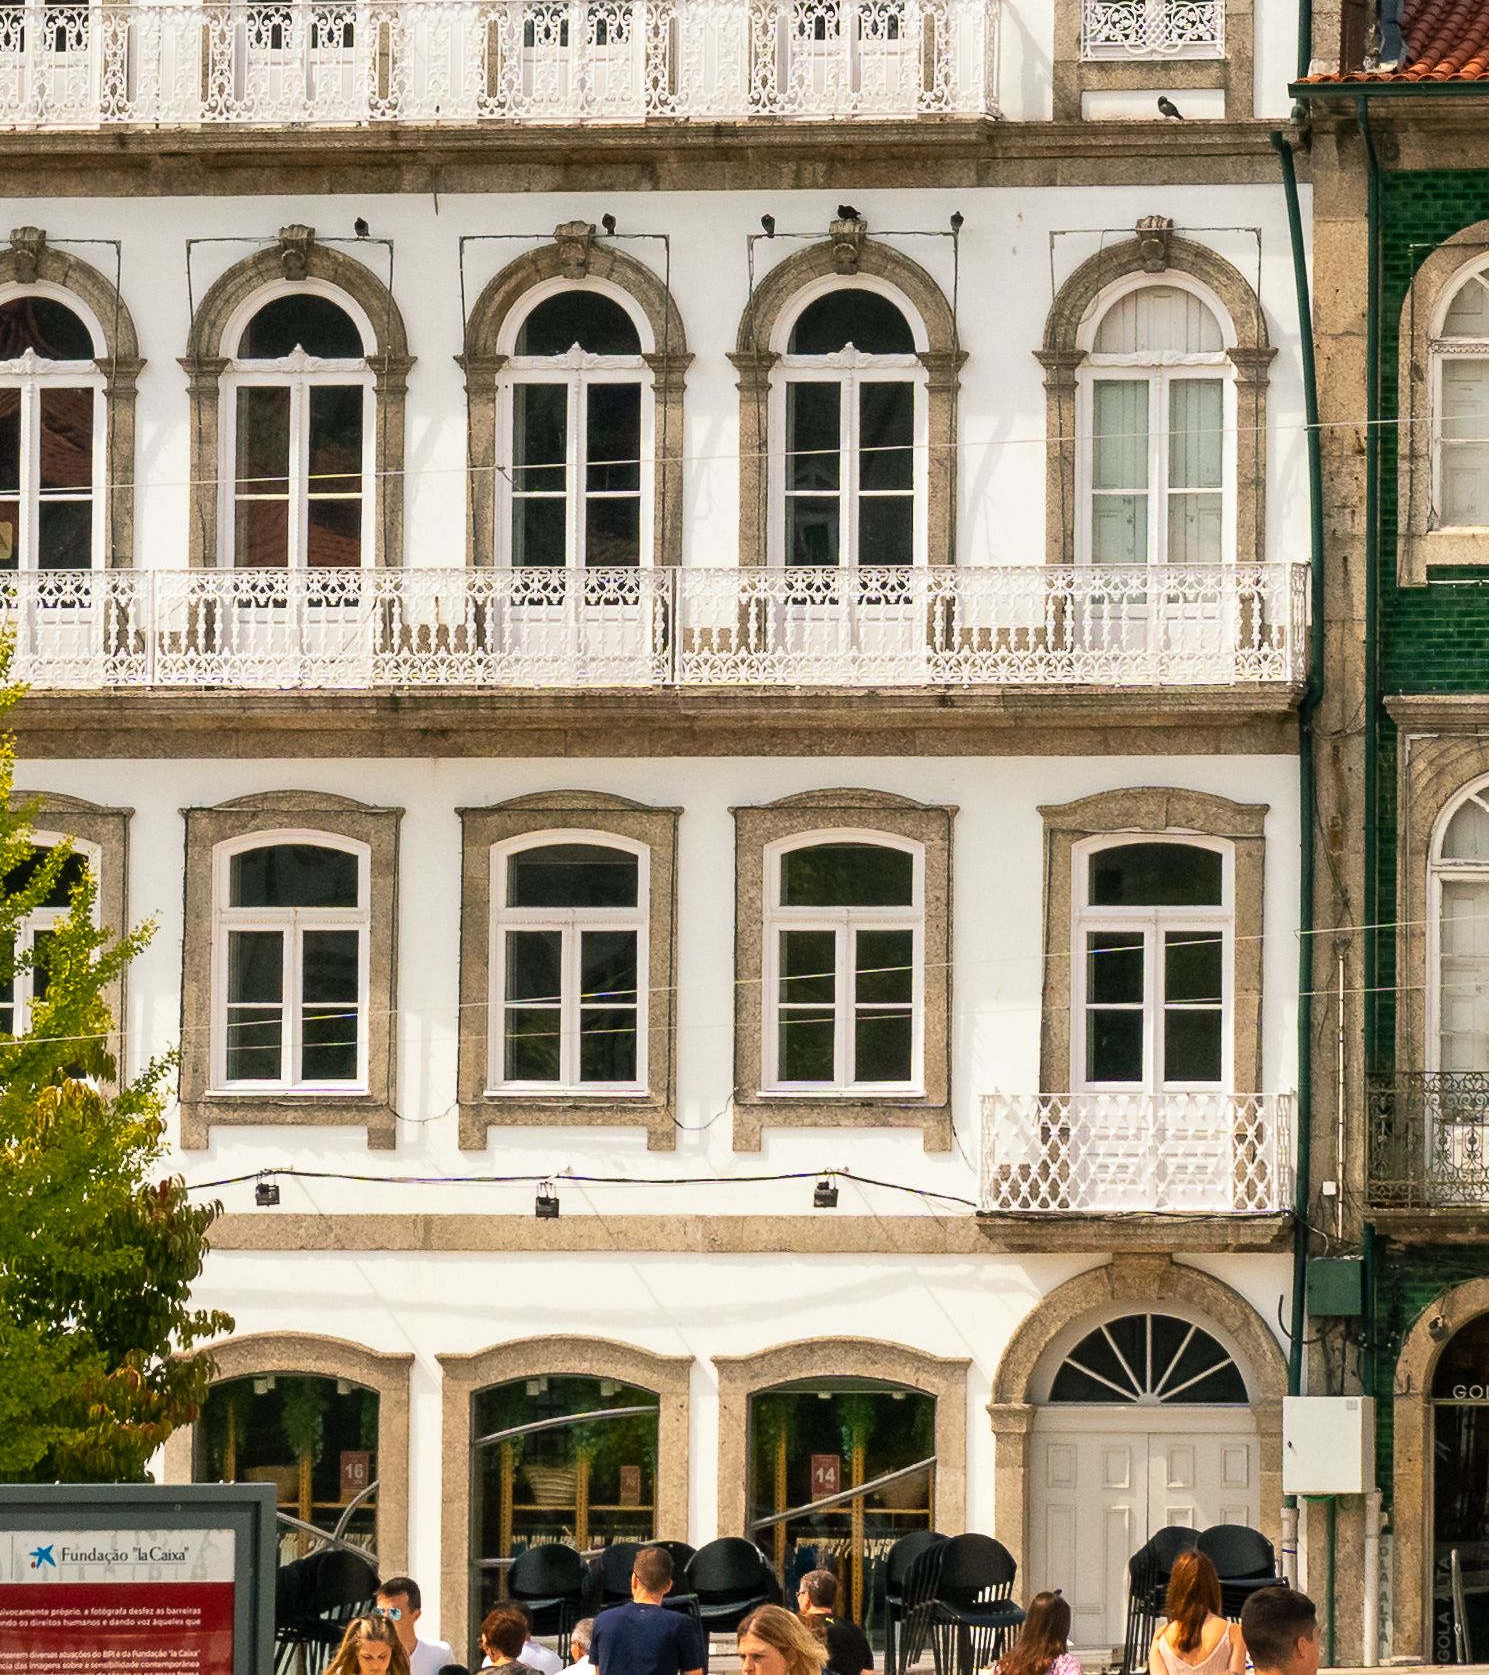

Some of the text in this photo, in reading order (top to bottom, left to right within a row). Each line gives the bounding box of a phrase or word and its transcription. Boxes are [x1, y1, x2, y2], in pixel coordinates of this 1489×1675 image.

[344, 1463, 364, 1479] 16
[815, 1466, 836, 1483] 14
[62, 1546, 129, 1565] Fundação
[91, 1607, 128, 1617] fotógrafa
[166, 1607, 202, 1615] barreiras
[1437, 1557, 1451, 1662] GOLA ALTA
[109, 1618, 136, 1626] dando
[132, 1650, 168, 1659] Fundação
